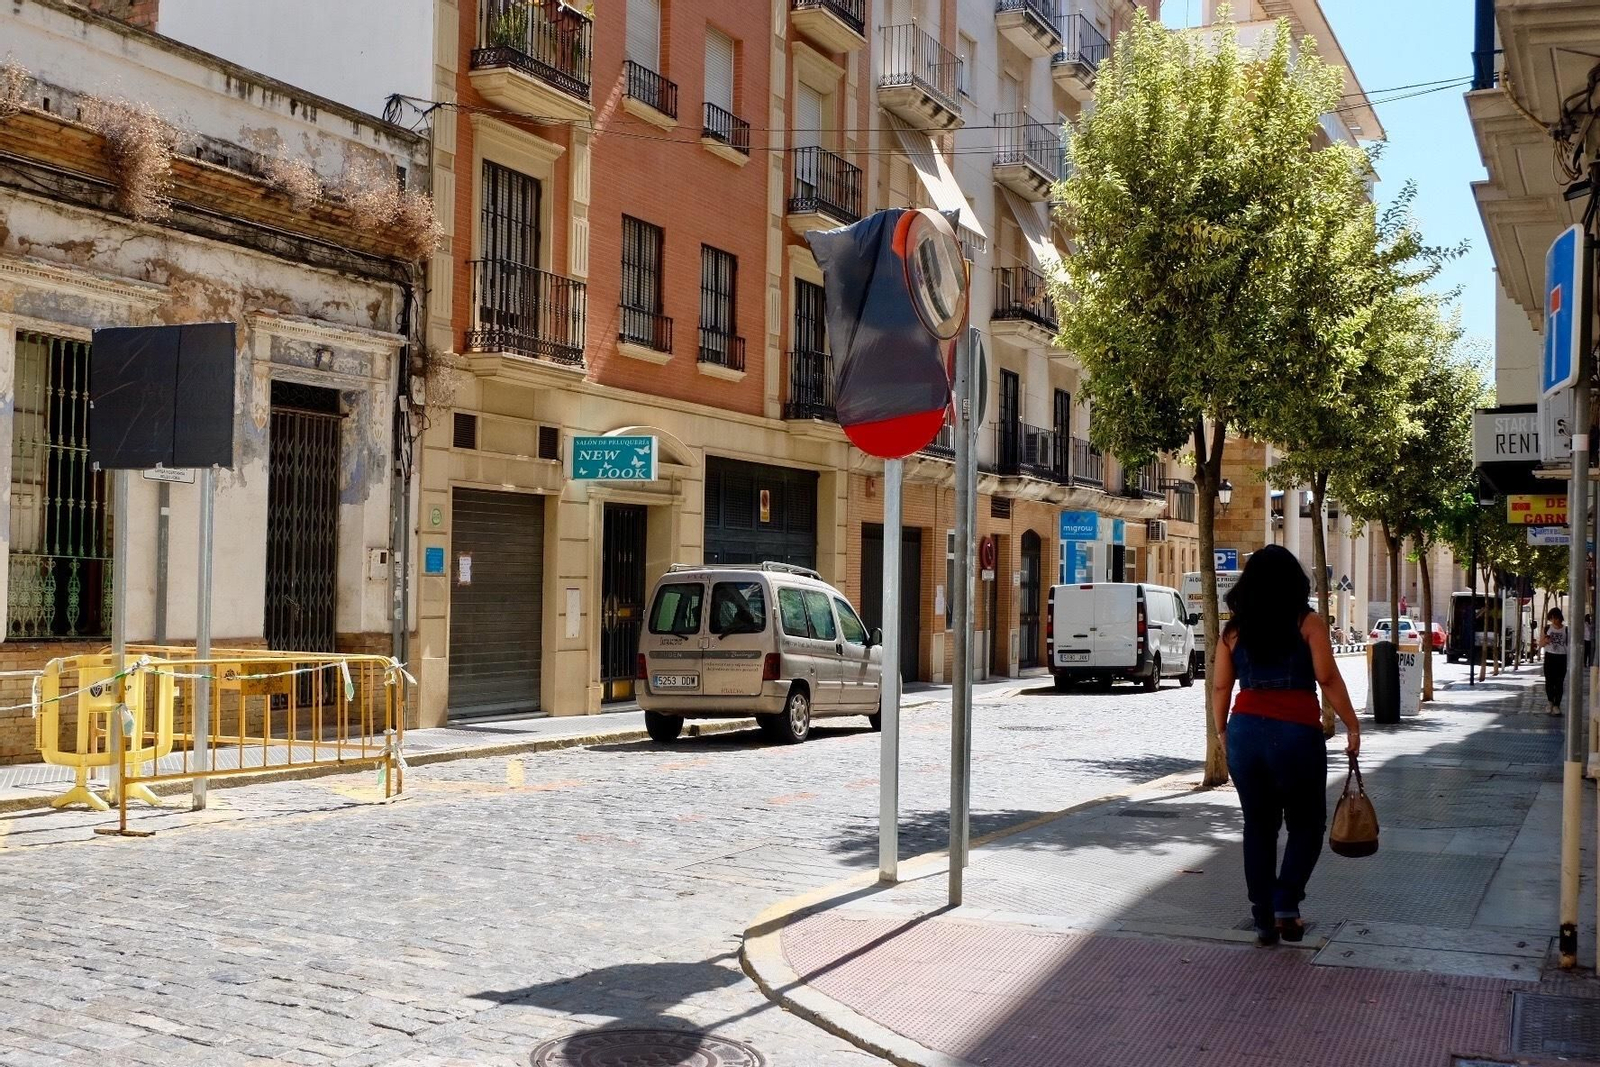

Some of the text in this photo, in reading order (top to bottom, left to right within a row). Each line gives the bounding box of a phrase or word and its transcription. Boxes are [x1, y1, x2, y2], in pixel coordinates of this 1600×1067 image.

[1495, 418, 1527, 433] STAR
[608, 439, 650, 447] PELUQUERÍA
[1496, 433, 1539, 454] RENT
[578, 450, 620, 461] NEW
[596, 468, 647, 479] LOOK
[1063, 526, 1093, 534] migrow
[658, 676, 677, 686] 5253
